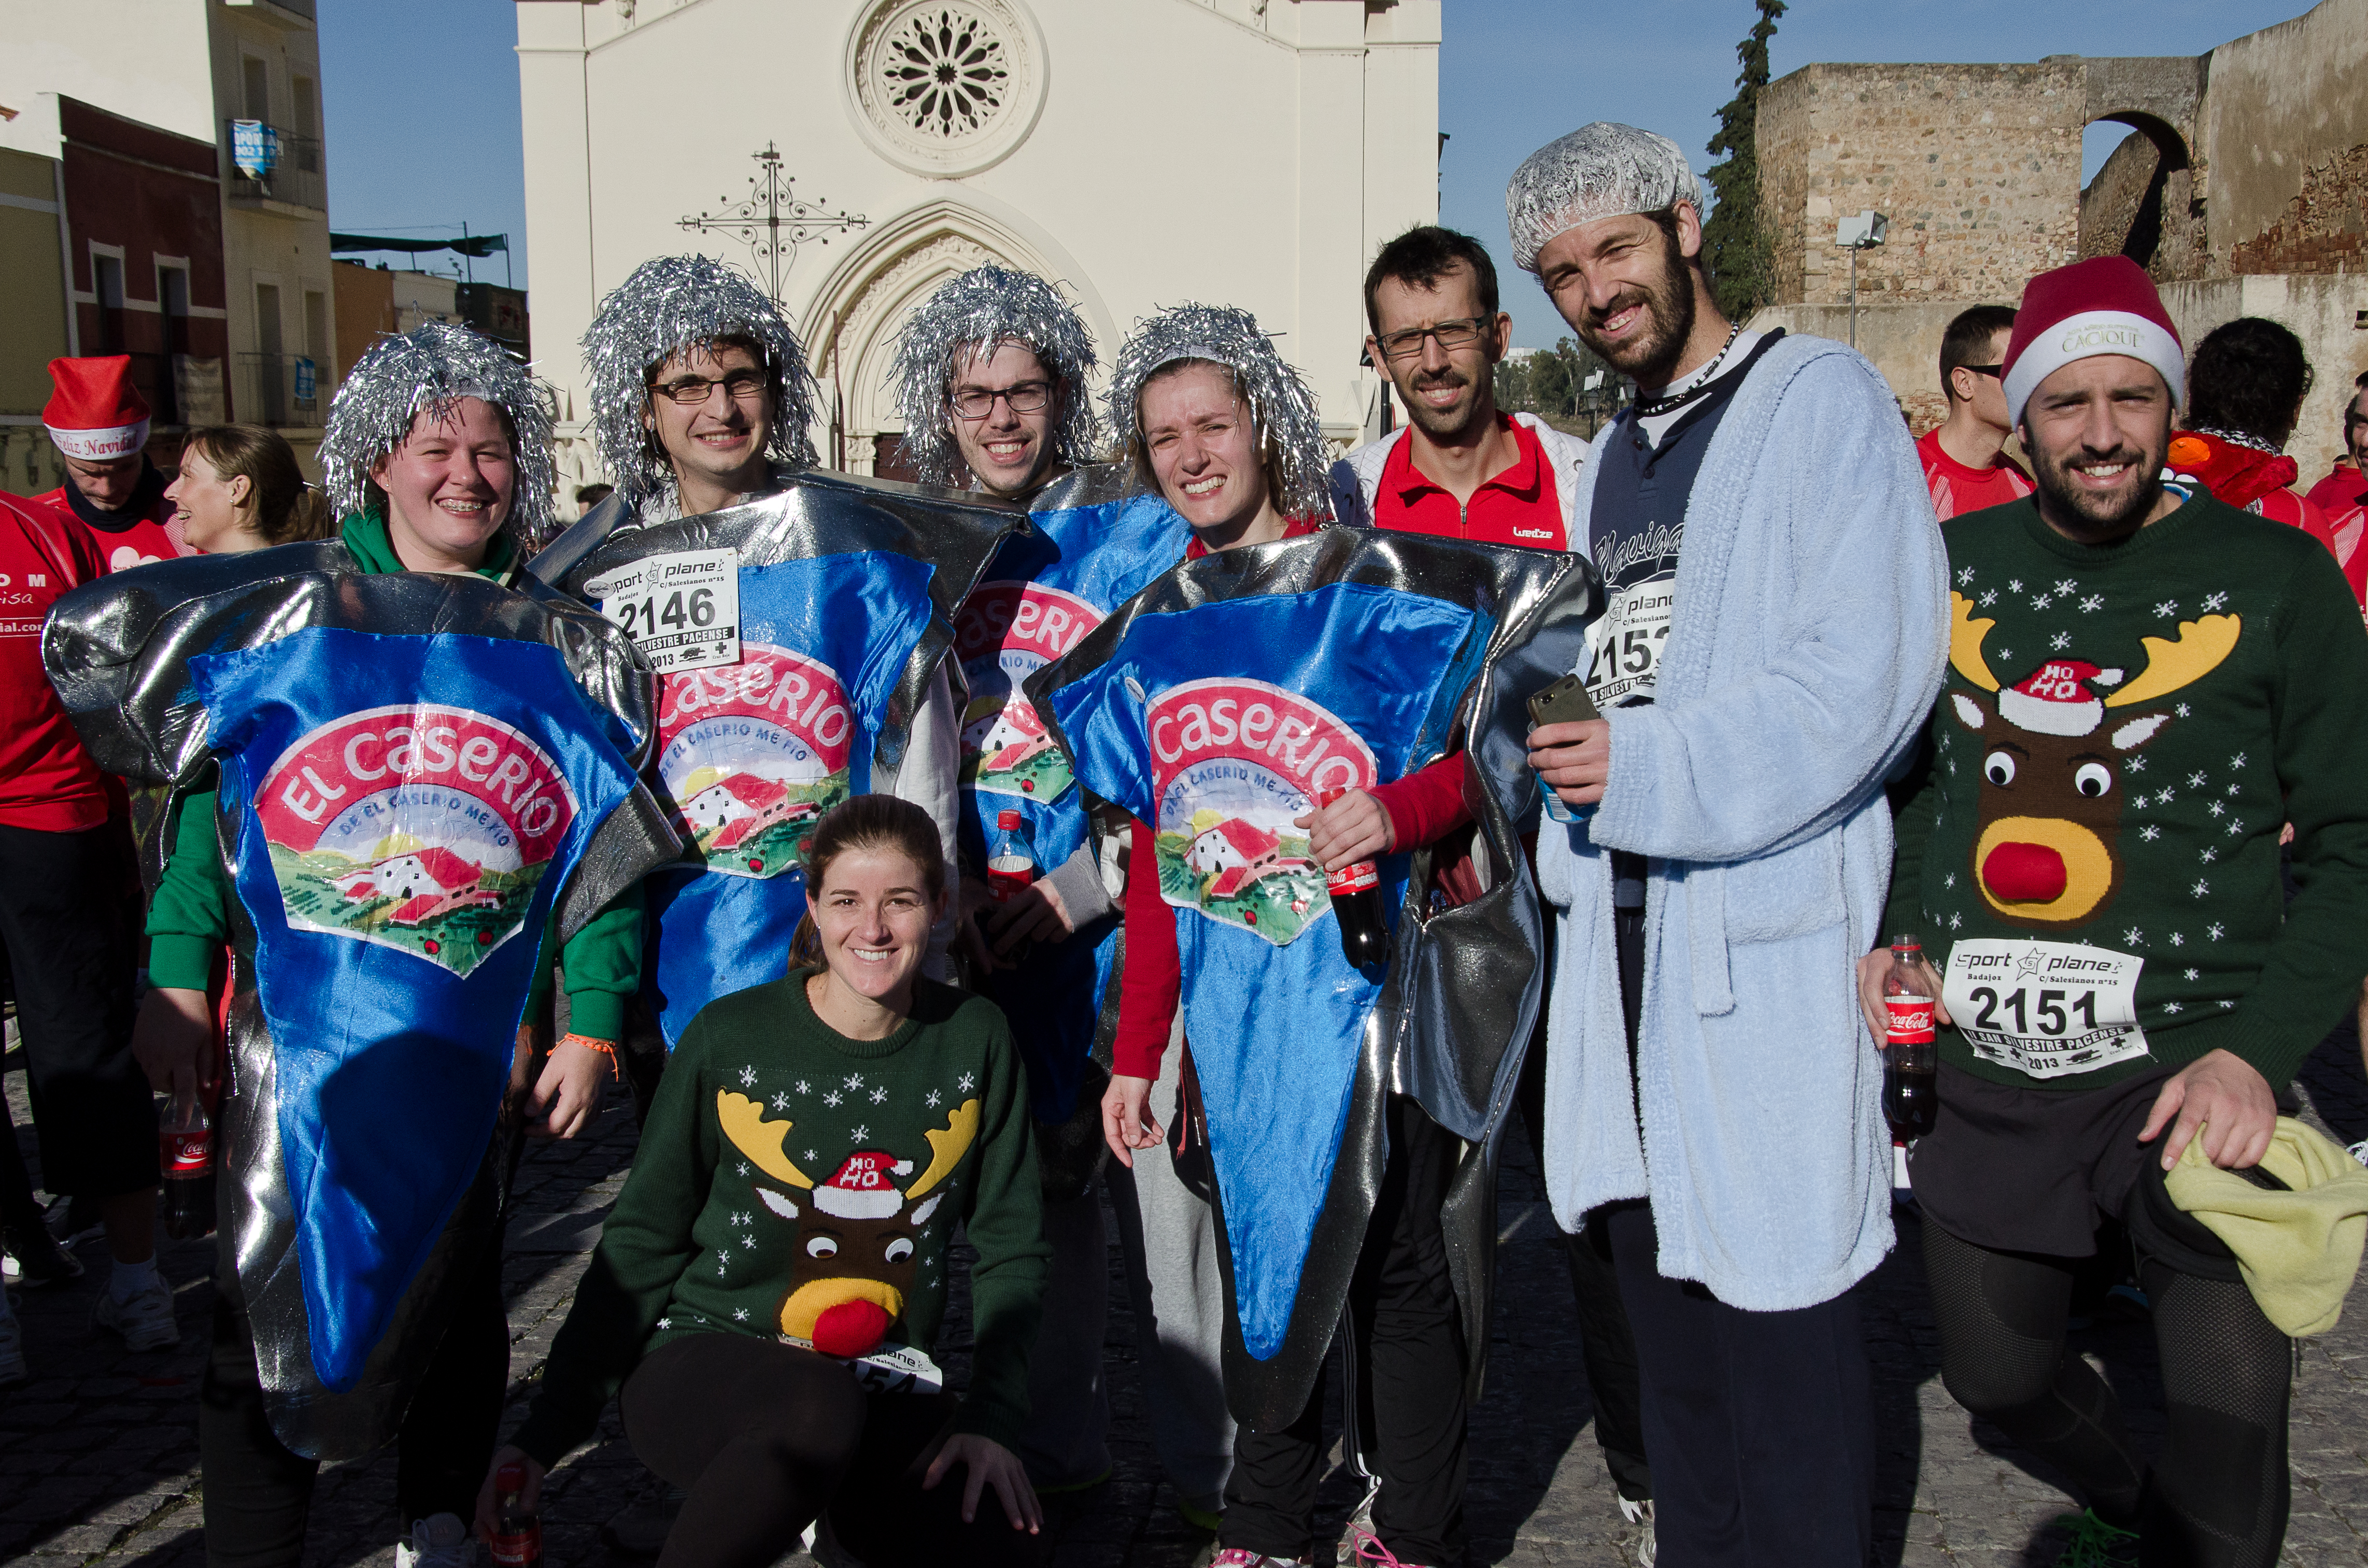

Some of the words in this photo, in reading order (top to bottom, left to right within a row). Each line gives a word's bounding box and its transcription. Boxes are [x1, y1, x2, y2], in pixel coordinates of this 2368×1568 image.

[2063, 330, 2142, 352] CACIQUE
[611, 571, 642, 593] port
[0, 591, 33, 605] isa
[619, 588, 716, 640] 2146
[682, 628, 729, 644] PACENSE
[652, 653, 674, 668] 2013
[2029, 677, 2077, 699] HO
[755, 728, 781, 744] ME
[339, 814, 362, 835] DE
[363, 803, 385, 818] EL
[465, 803, 490, 825] ME
[1955, 952, 2012, 970] Sport
[2039, 976, 2095, 985] C/Salesianos
[1970, 987, 2099, 1036] 2151
[1979, 1032, 2002, 1044] SAN
[2004, 1035, 2062, 1052] SILVESTRE
[2066, 1027, 2125, 1050] PACENSE
[2029, 1056, 2060, 1071] 2013
[840, 1170, 879, 1187] HO
